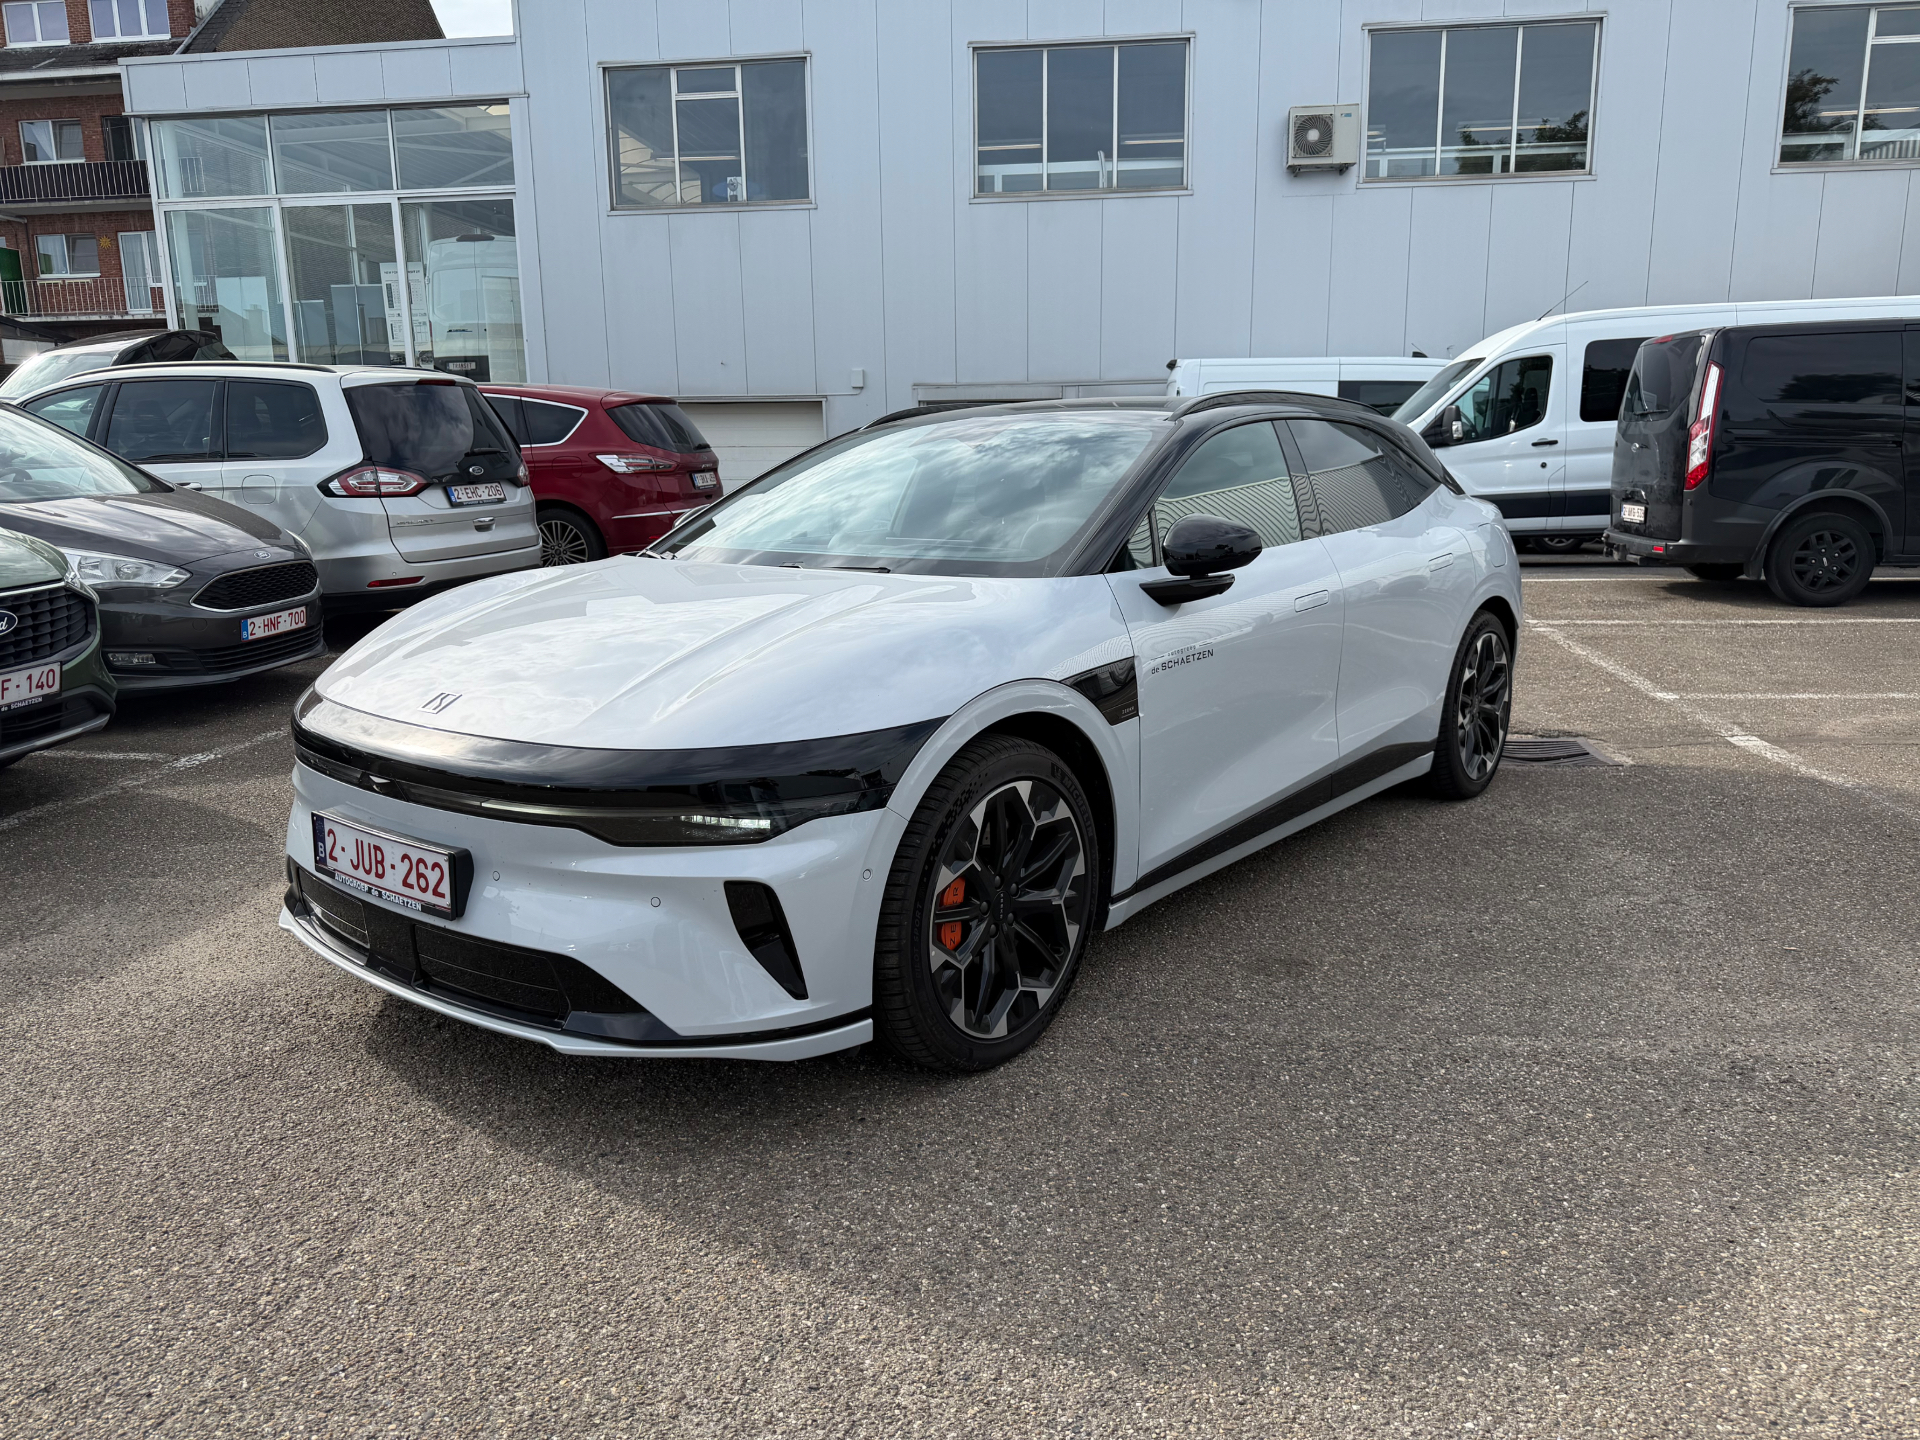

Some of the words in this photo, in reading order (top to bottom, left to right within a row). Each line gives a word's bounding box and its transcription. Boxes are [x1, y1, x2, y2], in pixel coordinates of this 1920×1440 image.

[249, 609, 305, 637] 2-HNF-700
[1161, 648, 1214, 671] SCHAETZEN
[10, 696, 43, 710] SCHAETZEN
[1062, 775, 1095, 838] MICHELIN
[318, 841, 325, 858] B
[327, 828, 446, 899] 2-JUB-262
[334, 872, 369, 893] AUTOGROEP
[371, 886, 379, 898] de
[381, 891, 422, 912] SCHAETZEN
[912, 901, 923, 943] SPORT
